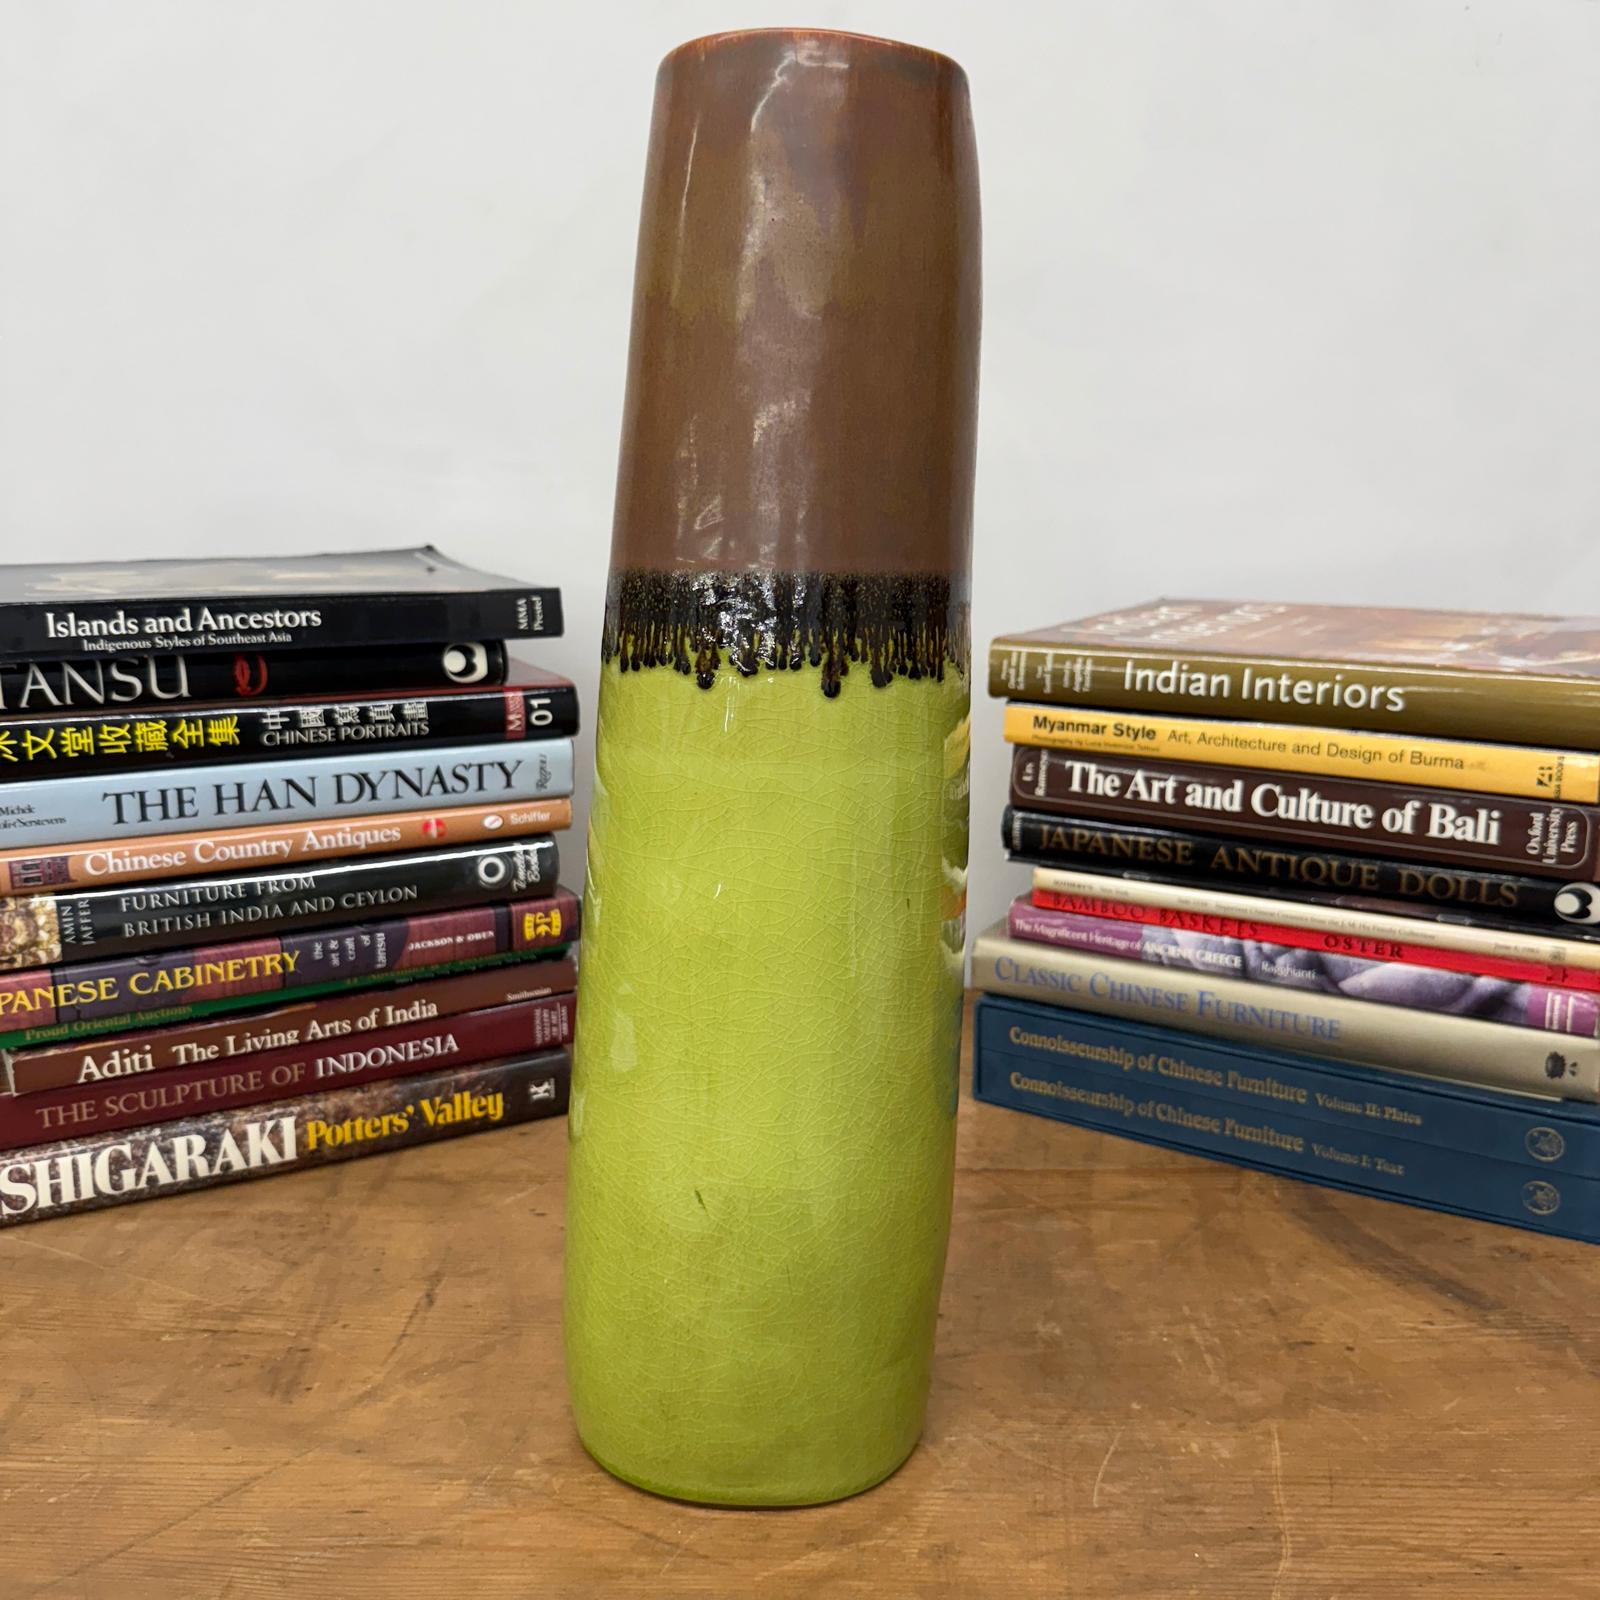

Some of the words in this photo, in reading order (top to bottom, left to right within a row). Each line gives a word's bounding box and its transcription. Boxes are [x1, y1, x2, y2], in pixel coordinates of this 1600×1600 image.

[46, 610, 139, 638] Islands
[144, 607, 194, 633] and
[198, 606, 322, 632] Ancestors
[83, 638, 152, 653] Indigenous
[155, 636, 191, 650] Styles
[193, 634, 207, 647] of
[208, 632, 266, 646] Southeast
[268, 632, 292, 643] Asia
[0, 655, 192, 710] TANSU
[1124, 659, 1232, 699] Indian
[1241, 667, 1406, 712] Interiors
[262, 727, 337, 747] CHINESE
[341, 721, 430, 741] PORTRAITS
[1033, 715, 1108, 736] Myanmar
[1112, 722, 1157, 742] Style
[1196, 732, 1288, 752] Architecture
[1292, 742, 1321, 756] and
[1326, 743, 1382, 765] Design
[1388, 749, 1405, 764] of
[1409, 752, 1465, 770] Burma
[102, 786, 200, 826] THE
[212, 776, 318, 817] HAN
[332, 760, 523, 805] DYNASTY
[1065, 760, 1120, 796] The
[1124, 769, 1177, 805] Art
[1185, 779, 1242, 813] and
[1250, 782, 1375, 830] Culture
[1381, 799, 1422, 835] of
[1425, 802, 1501, 846] Bali
[510, 811, 551, 825] Schiffer
[1525, 811, 1545, 855] Oxford
[1542, 807, 1565, 864] University
[1560, 820, 1579, 854] Press
[84, 848, 187, 876] Chinese
[193, 838, 294, 864] Country
[302, 825, 402, 852] Antiques
[1039, 824, 1195, 866] JAPANESE
[1210, 846, 1379, 890] ANTIQUE
[1398, 868, 1520, 908] DOLLS
[120, 882, 247, 912] FURNITURE
[256, 876, 316, 896] FROM
[123, 912, 211, 939] BRITISH
[220, 903, 284, 926] INDIA
[290, 896, 335, 917] AND
[341, 885, 418, 909] CEYLON
[1052, 893, 1147, 919] BAMBOO
[1158, 907, 1259, 937] BASKETS
[61, 905, 76, 945] AMIN
[360, 934, 371, 947] of
[408, 936, 454, 951] JACKSON
[456, 934, 465, 944] &
[1015, 918, 1033, 931] The
[1033, 923, 1088, 943] Magnificent
[1196, 950, 1242, 969] GREECE
[1323, 933, 1405, 959] OSTER
[313, 941, 324, 960] the
[345, 937, 356, 961] craft
[375, 932, 387, 969] tansu
[0, 977, 119, 1017] PANESE
[129, 949, 300, 995] CABINETRY
[507, 986, 552, 1001] Smithsonian
[994, 956, 1082, 993] CLASSIC
[1089, 971, 1191, 1011] CHINESE
[1196, 990, 1341, 1041] FURNITURE
[24, 1025, 69, 1041] Proud
[73, 1014, 132, 1032] Oriental
[135, 1004, 193, 1022] Auctions
[77, 1045, 156, 1084] Aditi
[172, 1042, 220, 1065] The
[226, 1028, 299, 1057] Living
[306, 1018, 351, 1041] Arts
[357, 1007, 379, 1029] of
[384, 998, 438, 1026] India
[35, 1099, 99, 1129] THE
[106, 1071, 265, 1118] SCULPTURE
[271, 1063, 306, 1087] OF
[315, 1034, 460, 1079] INDONESIA
[1009, 1026, 1134, 1072] Connoisseurship
[1137, 1053, 1156, 1072] of
[1156, 1056, 1224, 1087] Chinese
[1226, 1071, 1308, 1104] Furniture
[1315, 1092, 1363, 1114] Volume
[1382, 1105, 1423, 1126] Plates
[1009, 1071, 1134, 1116] Connoisseurship
[1137, 1099, 1155, 1118] of
[1155, 1103, 1221, 1133] Chinese
[1223, 1117, 1305, 1153] Furniture
[1311, 1142, 1360, 1165] Volume
[1374, 1157, 1405, 1177] Text
[0, 1114, 299, 1215] SHIGARAKI
[306, 1104, 414, 1151] Potters'
[420, 1091, 504, 1127] Valley
